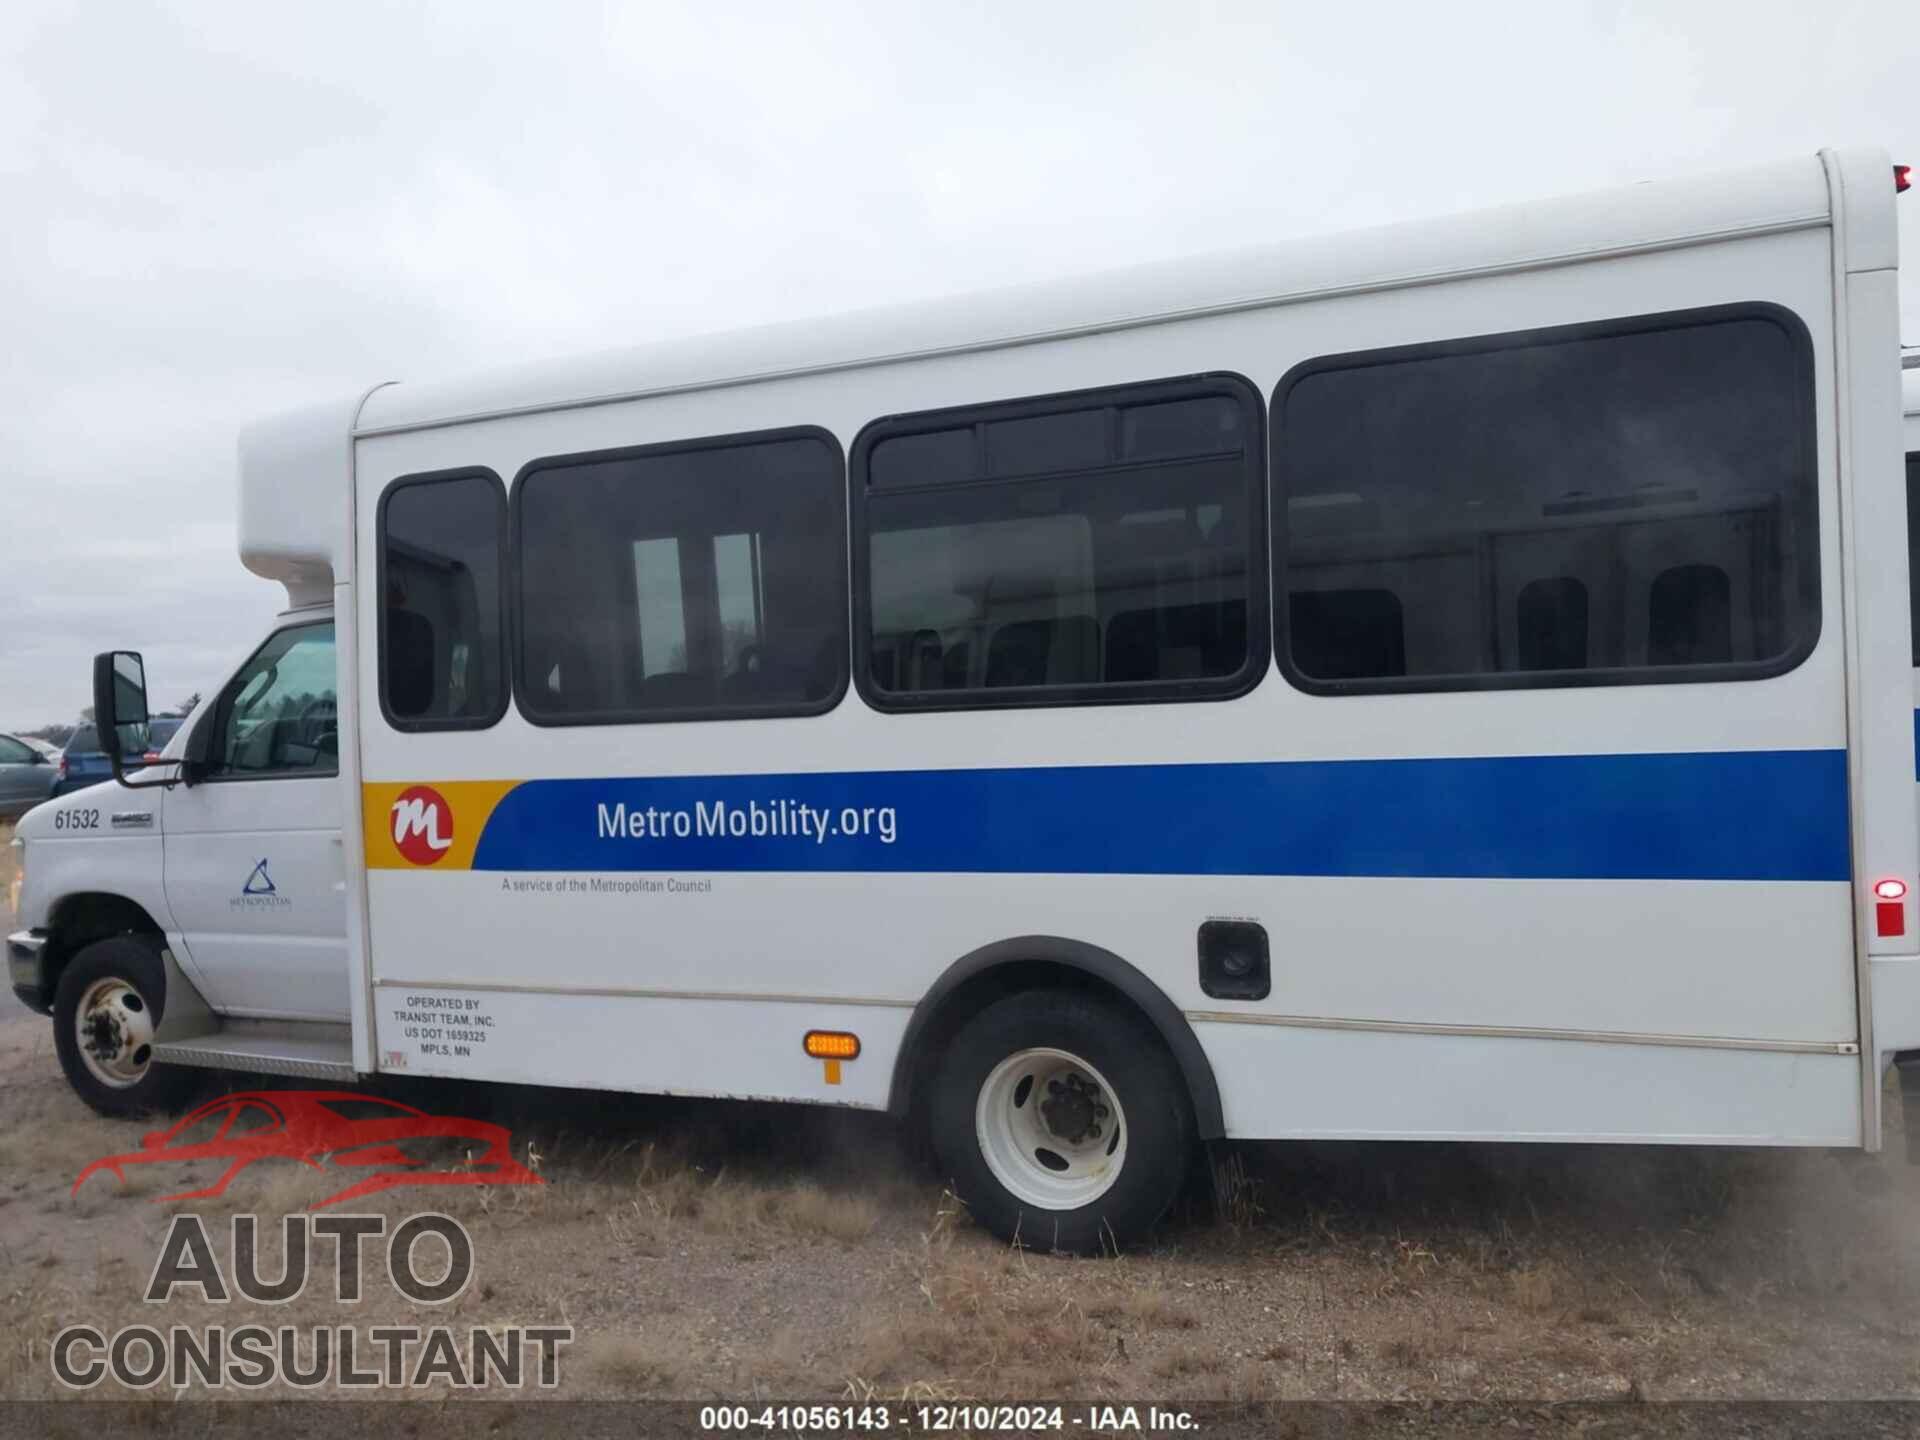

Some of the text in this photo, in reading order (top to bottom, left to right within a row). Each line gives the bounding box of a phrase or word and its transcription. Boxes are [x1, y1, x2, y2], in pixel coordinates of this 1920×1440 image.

[55, 808, 100, 829] 61532
[597, 800, 897, 844] MetroMobility.org
[502, 878, 712, 893] A service of the Metropolitan Council
[406, 996, 480, 1010] OPERATED BY
[393, 1011, 437, 1024] TRANSIT
[474, 1015, 496, 1028] INC.
[404, 1026, 486, 1043] US DOT 1659325
[454, 1045, 471, 1057] MN
